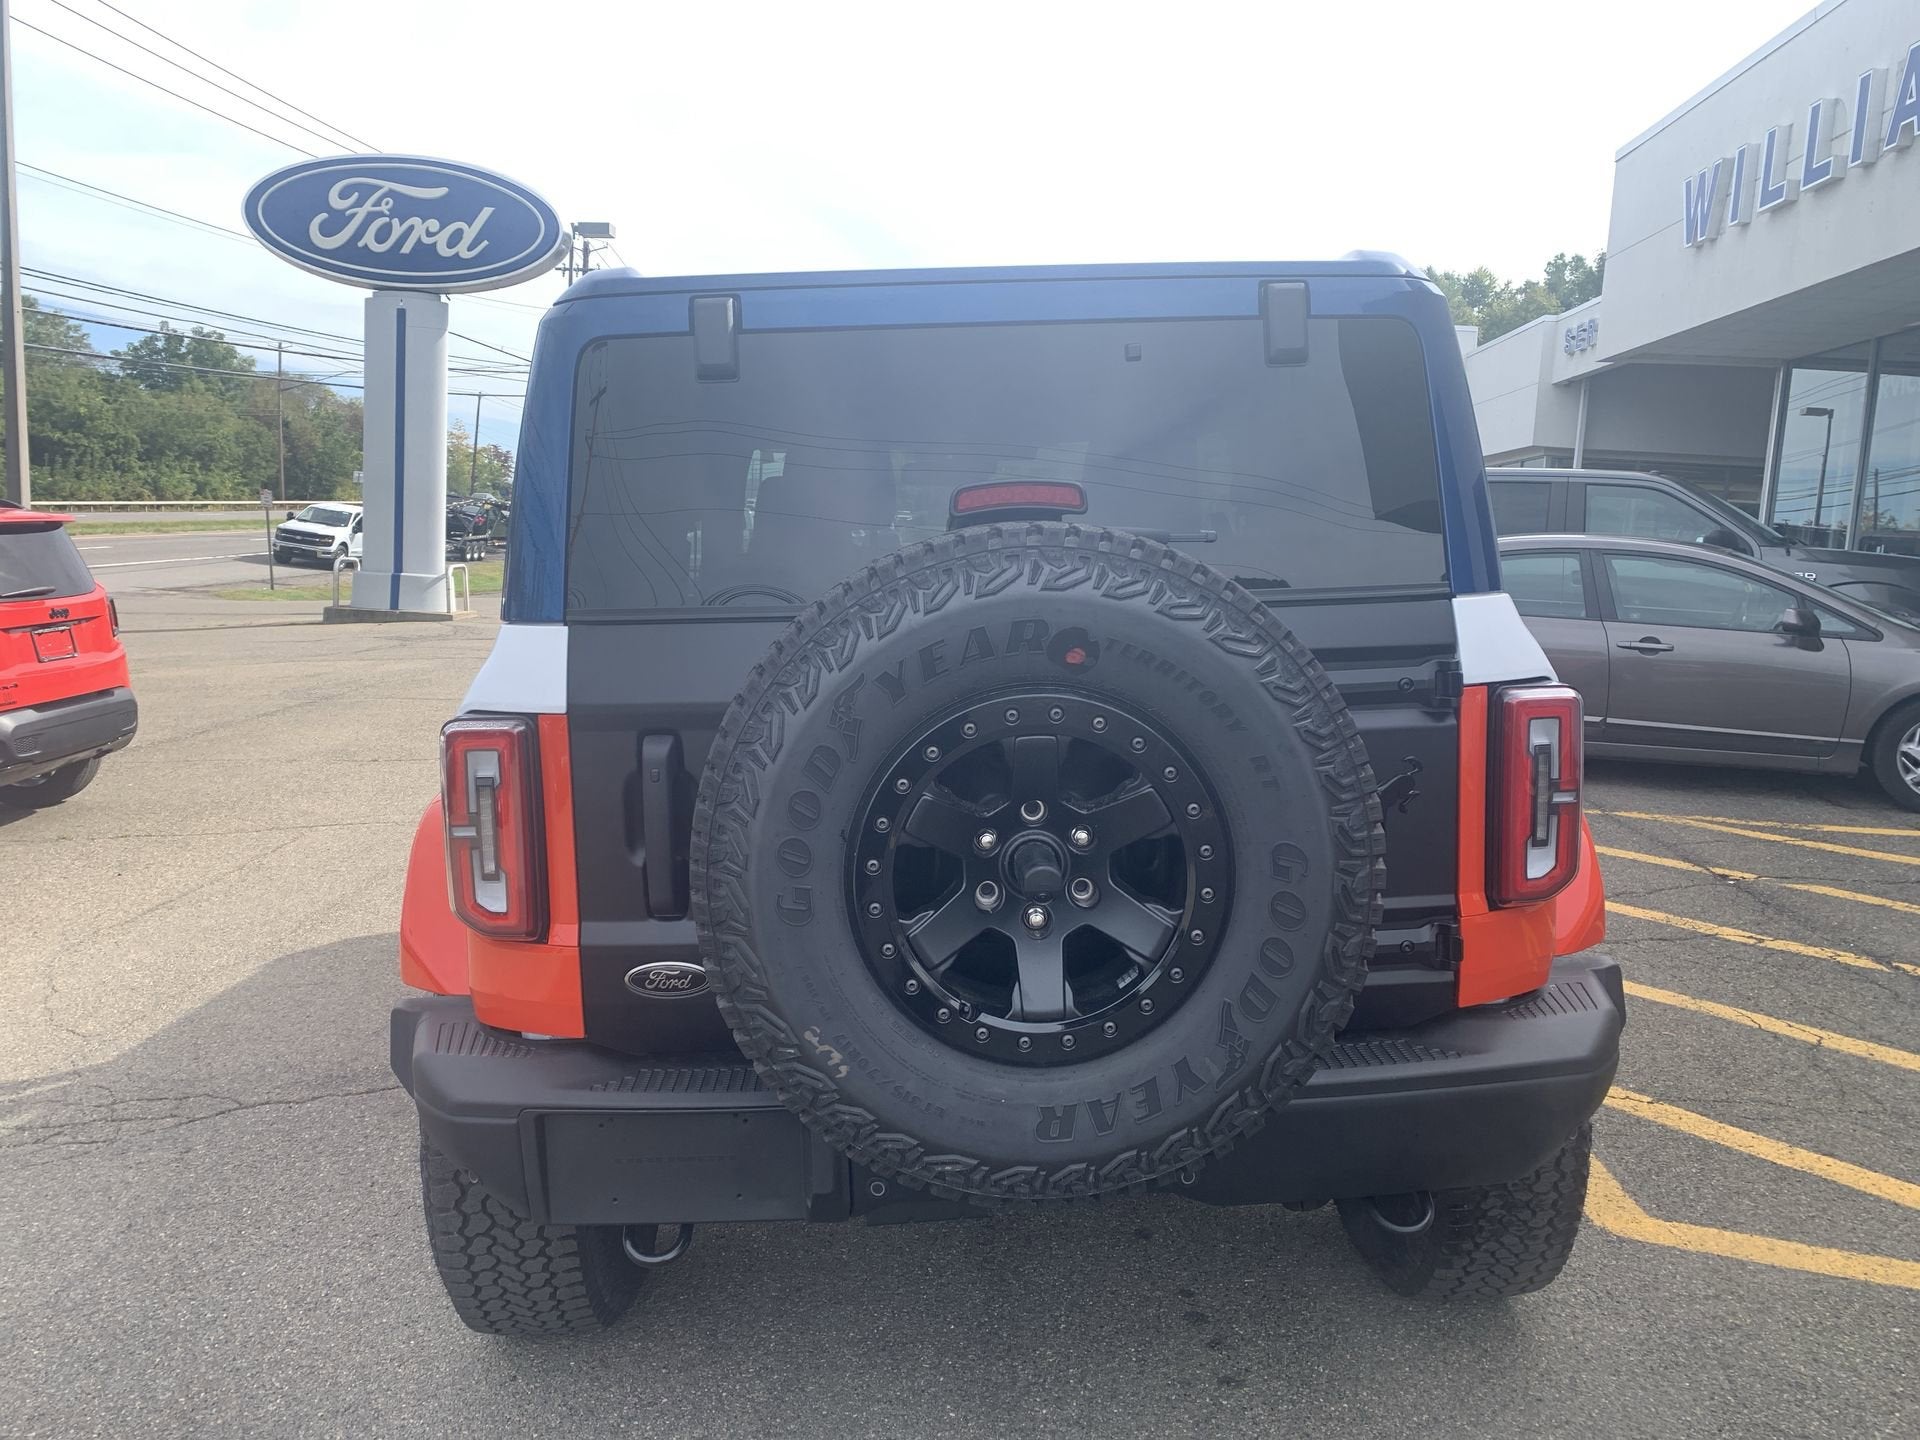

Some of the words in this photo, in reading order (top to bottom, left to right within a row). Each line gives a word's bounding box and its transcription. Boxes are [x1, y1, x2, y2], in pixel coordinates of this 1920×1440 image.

[1684, 40, 1920, 248] WILLIA
[309, 177, 496, 259] Ford
[49, 608, 70, 619] Jeep
[1104, 636, 1249, 732] TERRITORY
[645, 969, 693, 989] Ford
